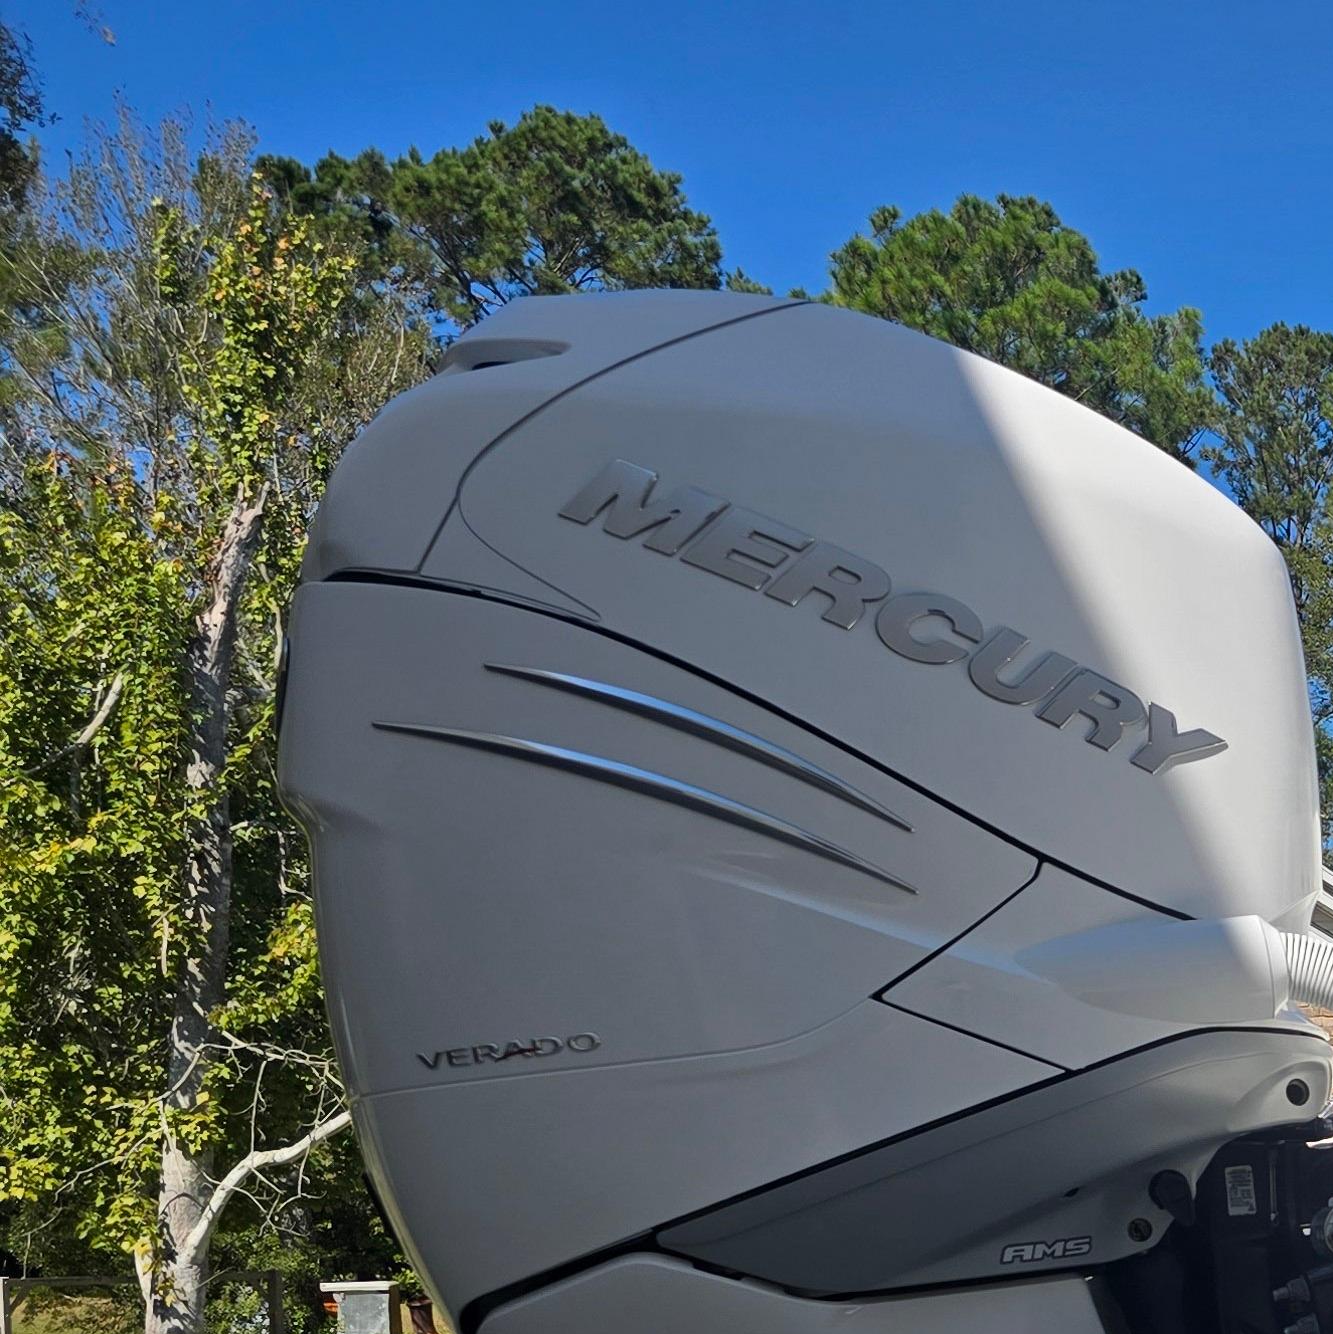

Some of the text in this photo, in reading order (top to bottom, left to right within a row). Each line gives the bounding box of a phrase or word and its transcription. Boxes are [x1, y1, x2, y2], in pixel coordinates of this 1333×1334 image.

[558, 459, 1228, 774] MERCURY
[415, 1031, 601, 1071] VERADO
[1001, 1236, 1091, 1264] AMS
